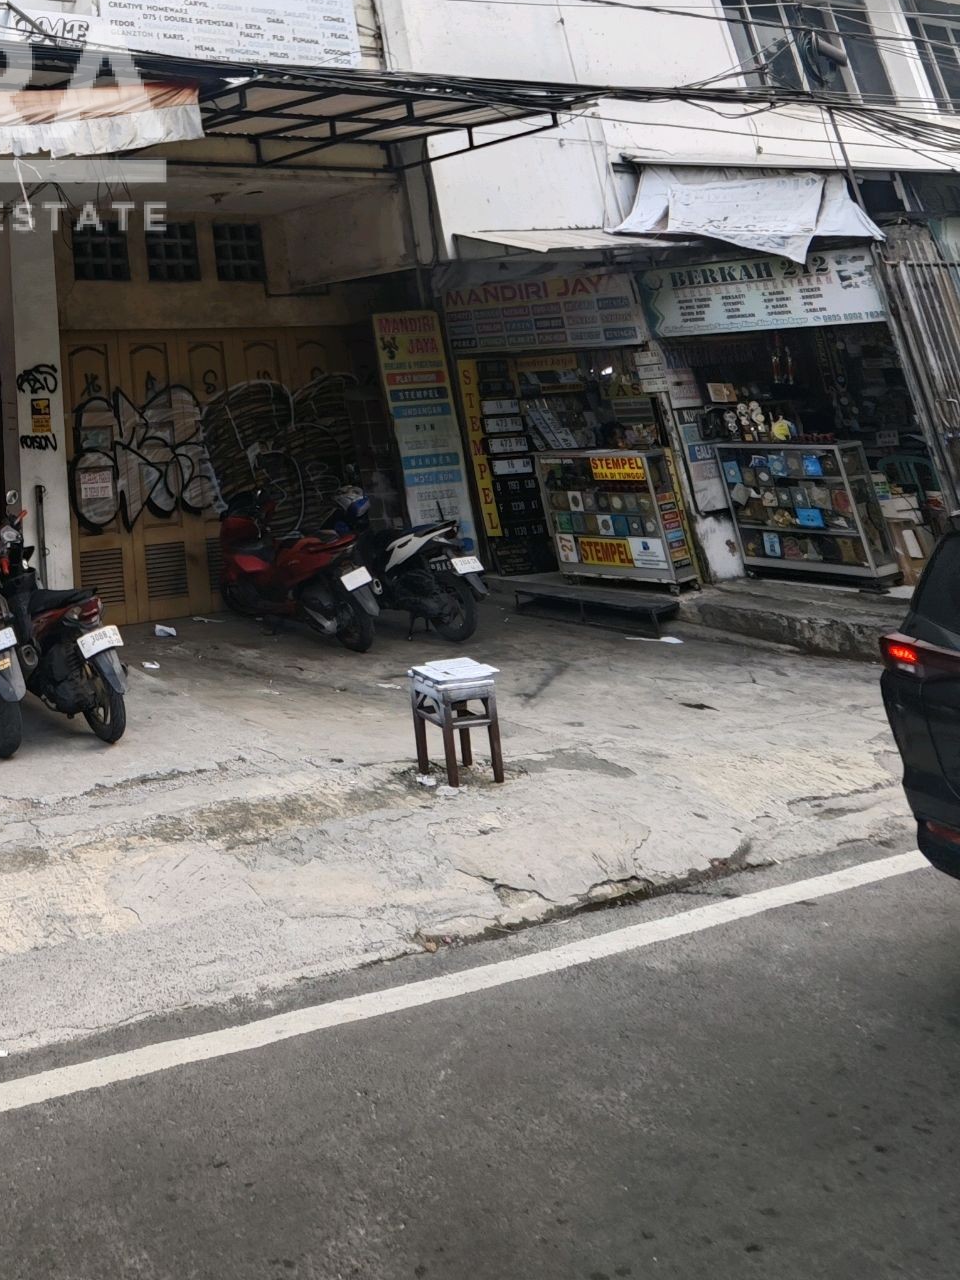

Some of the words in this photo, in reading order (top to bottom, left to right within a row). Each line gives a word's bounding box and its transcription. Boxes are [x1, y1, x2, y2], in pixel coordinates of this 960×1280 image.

[670, 260, 775, 289] BERKAH
[445, 280, 549, 307] MANDIRI
[378, 316, 436, 334] MANDIRI
[407, 335, 439, 354] JAYA
[399, 389, 440, 400] STEMPEL
[591, 457, 643, 470] STEMPEL
[580, 539, 634, 565] STEMPEL
